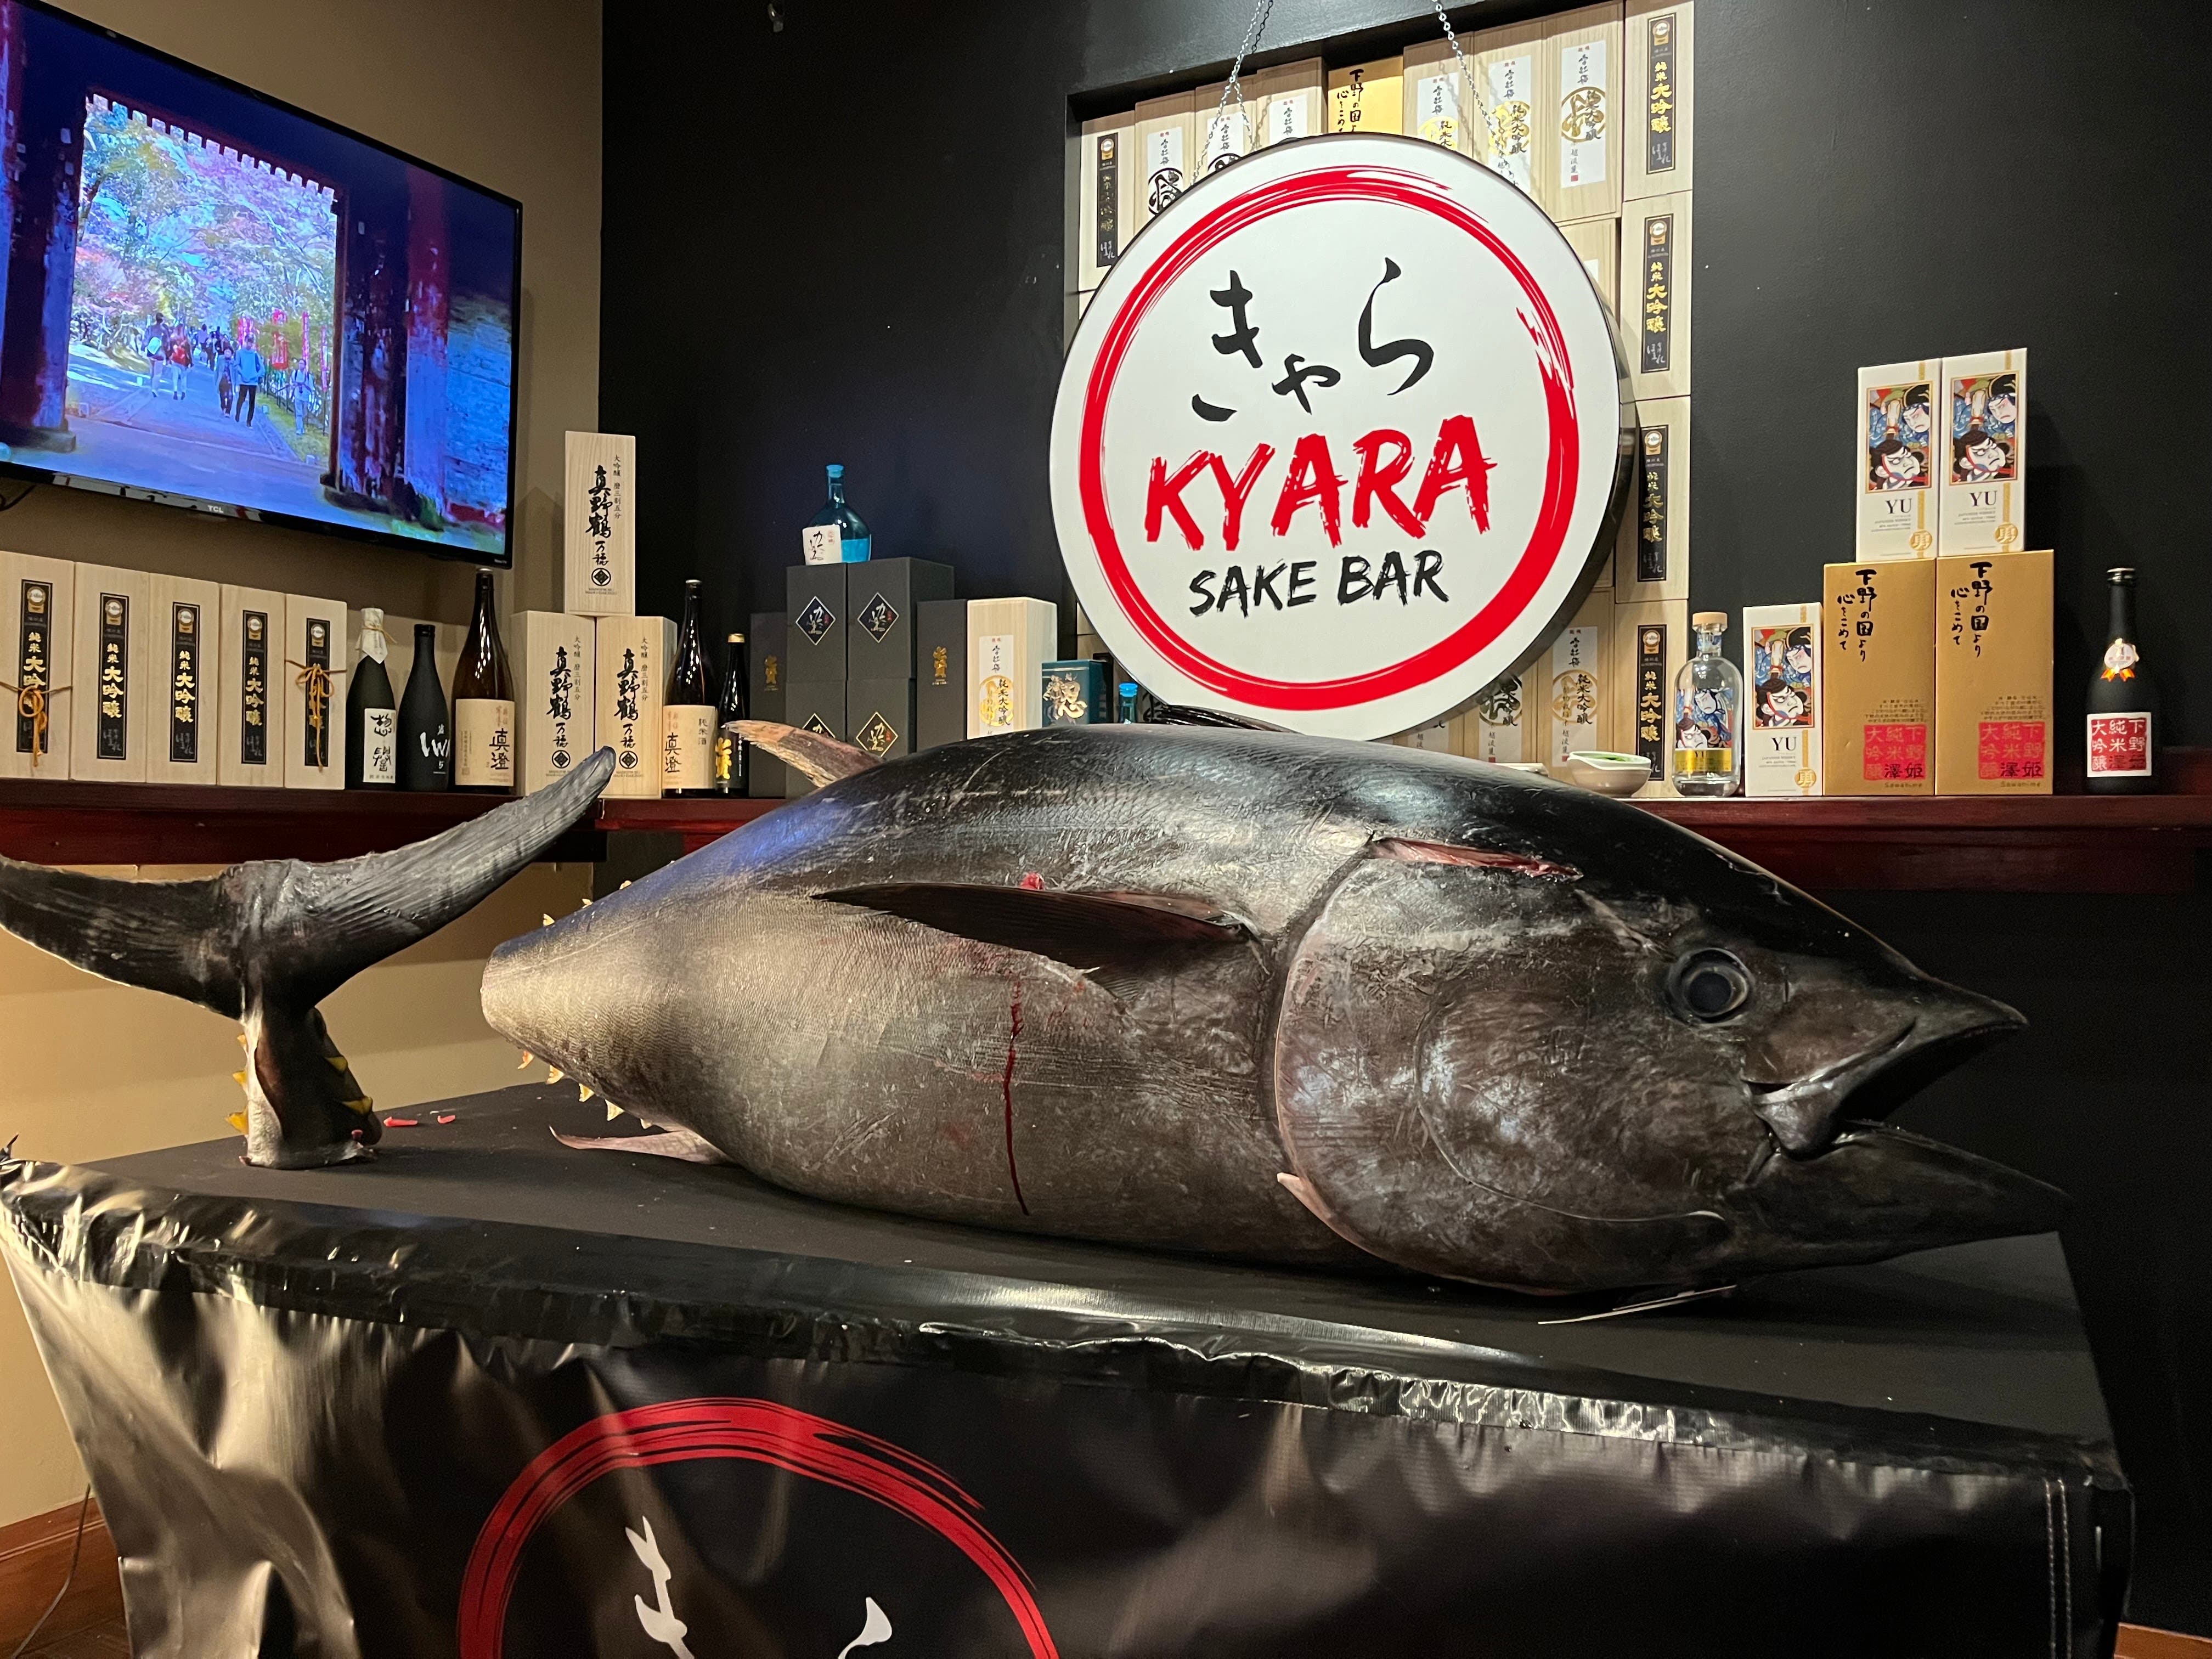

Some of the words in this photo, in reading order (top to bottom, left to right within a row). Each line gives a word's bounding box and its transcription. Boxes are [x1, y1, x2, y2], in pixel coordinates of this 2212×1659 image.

[1650, 61, 1672, 133] 純米大吟醸
[1646, 262, 1667, 333] 純米大吟醸
[1192, 257, 1435, 422] きゃら
[207, 505, 224, 514] TCL
[585, 465, 613, 538] 真野鶴
[1143, 414, 1497, 551] KYARA
[1643, 472, 1664, 543] 純米大吟醸
[1886, 498, 1912, 514] YU
[1969, 490, 1997, 507] YU
[1189, 559, 1317, 618] SAKE
[1338, 549, 1449, 605] BAR
[1855, 569, 1877, 662] 下野の国より
[1951, 588, 1970, 645] 心をこめて
[1970, 562, 1993, 658] 下野の国より
[1837, 594, 1855, 650] 心をこめて
[23, 631, 46, 708] 純米大吟
[103, 643, 123, 718] 純米大吟醸
[175, 651, 195, 723] 純米大吟醸
[246, 657, 264, 726] 純米大吟醸
[546, 646, 573, 720] 真野鶴
[614, 648, 640, 721] 真野鶴
[1576, 674, 1593, 725] 純米大吟醸
[1640, 671, 1662, 742] 純米大吟醸
[1771, 736, 1797, 751] YU
